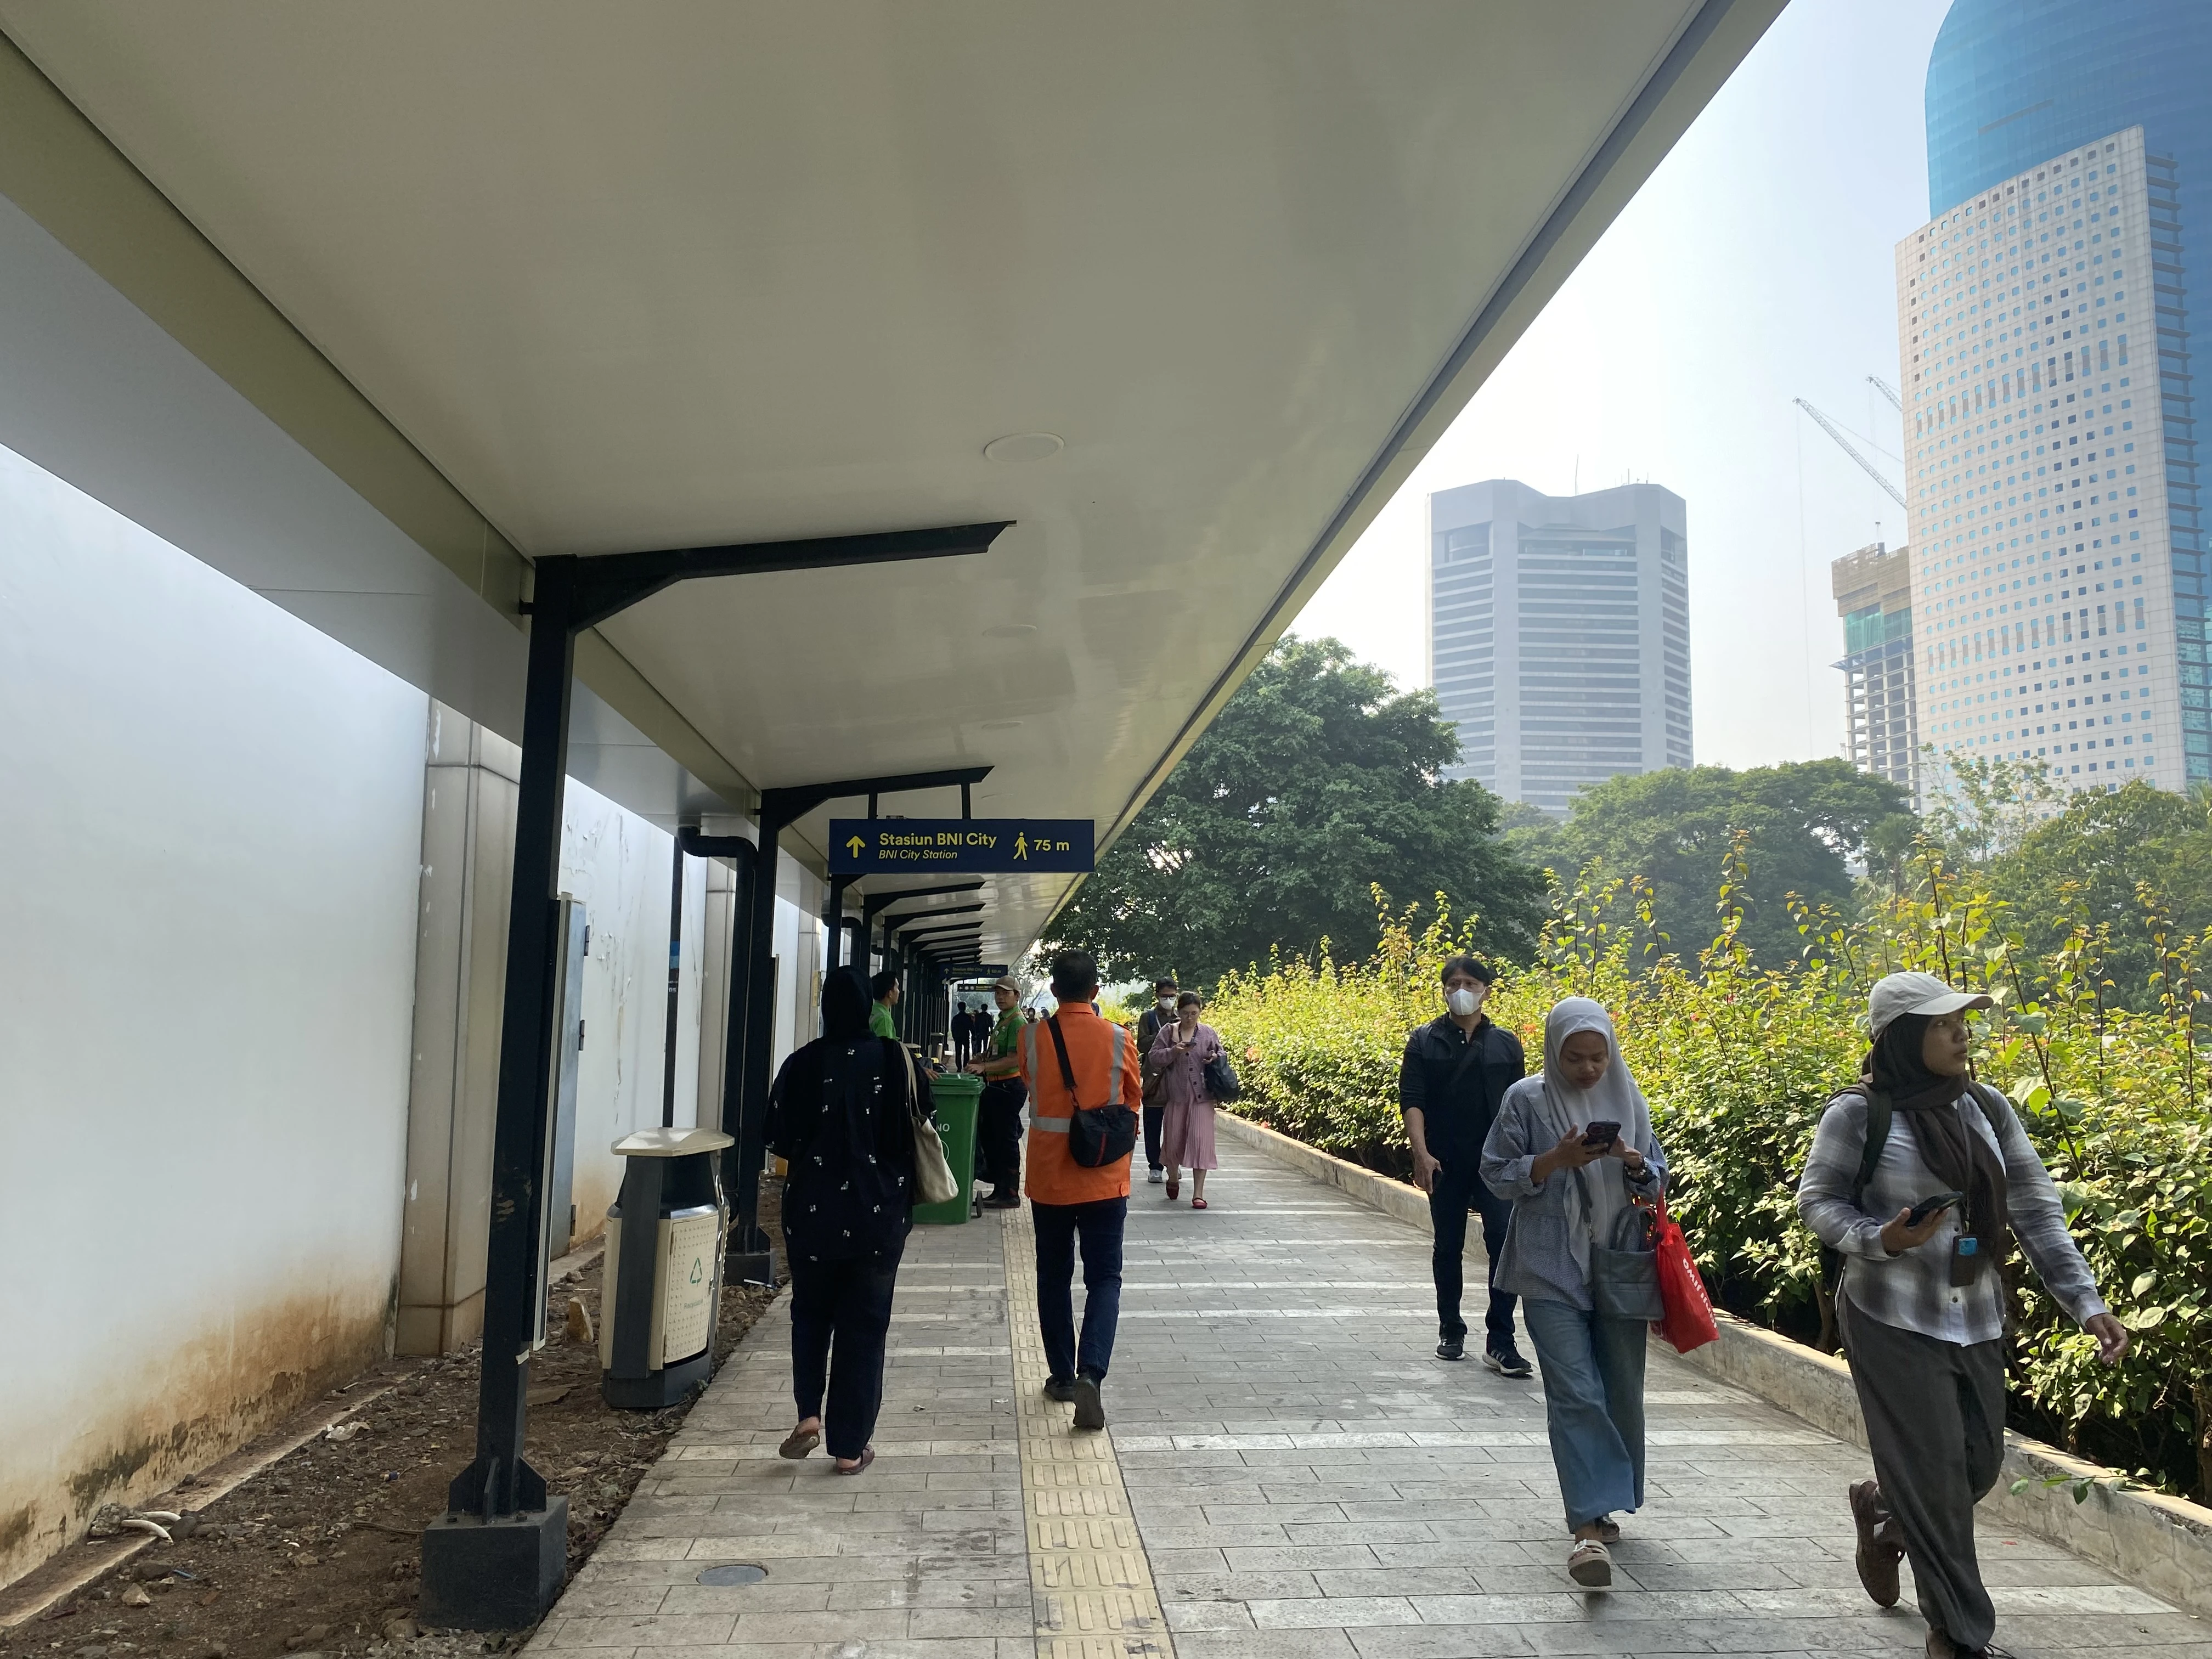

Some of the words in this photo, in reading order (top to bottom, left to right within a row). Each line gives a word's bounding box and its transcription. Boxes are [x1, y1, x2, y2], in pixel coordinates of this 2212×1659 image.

[879, 833, 932, 845] Stasiun
[937, 833, 962, 845] BNI
[966, 832, 997, 848] City
[1034, 839, 1051, 851] 75
[1057, 842, 1070, 851] m
[878, 850, 898, 859] BNI
[900, 849, 921, 861] City
[922, 849, 958, 859] Station
